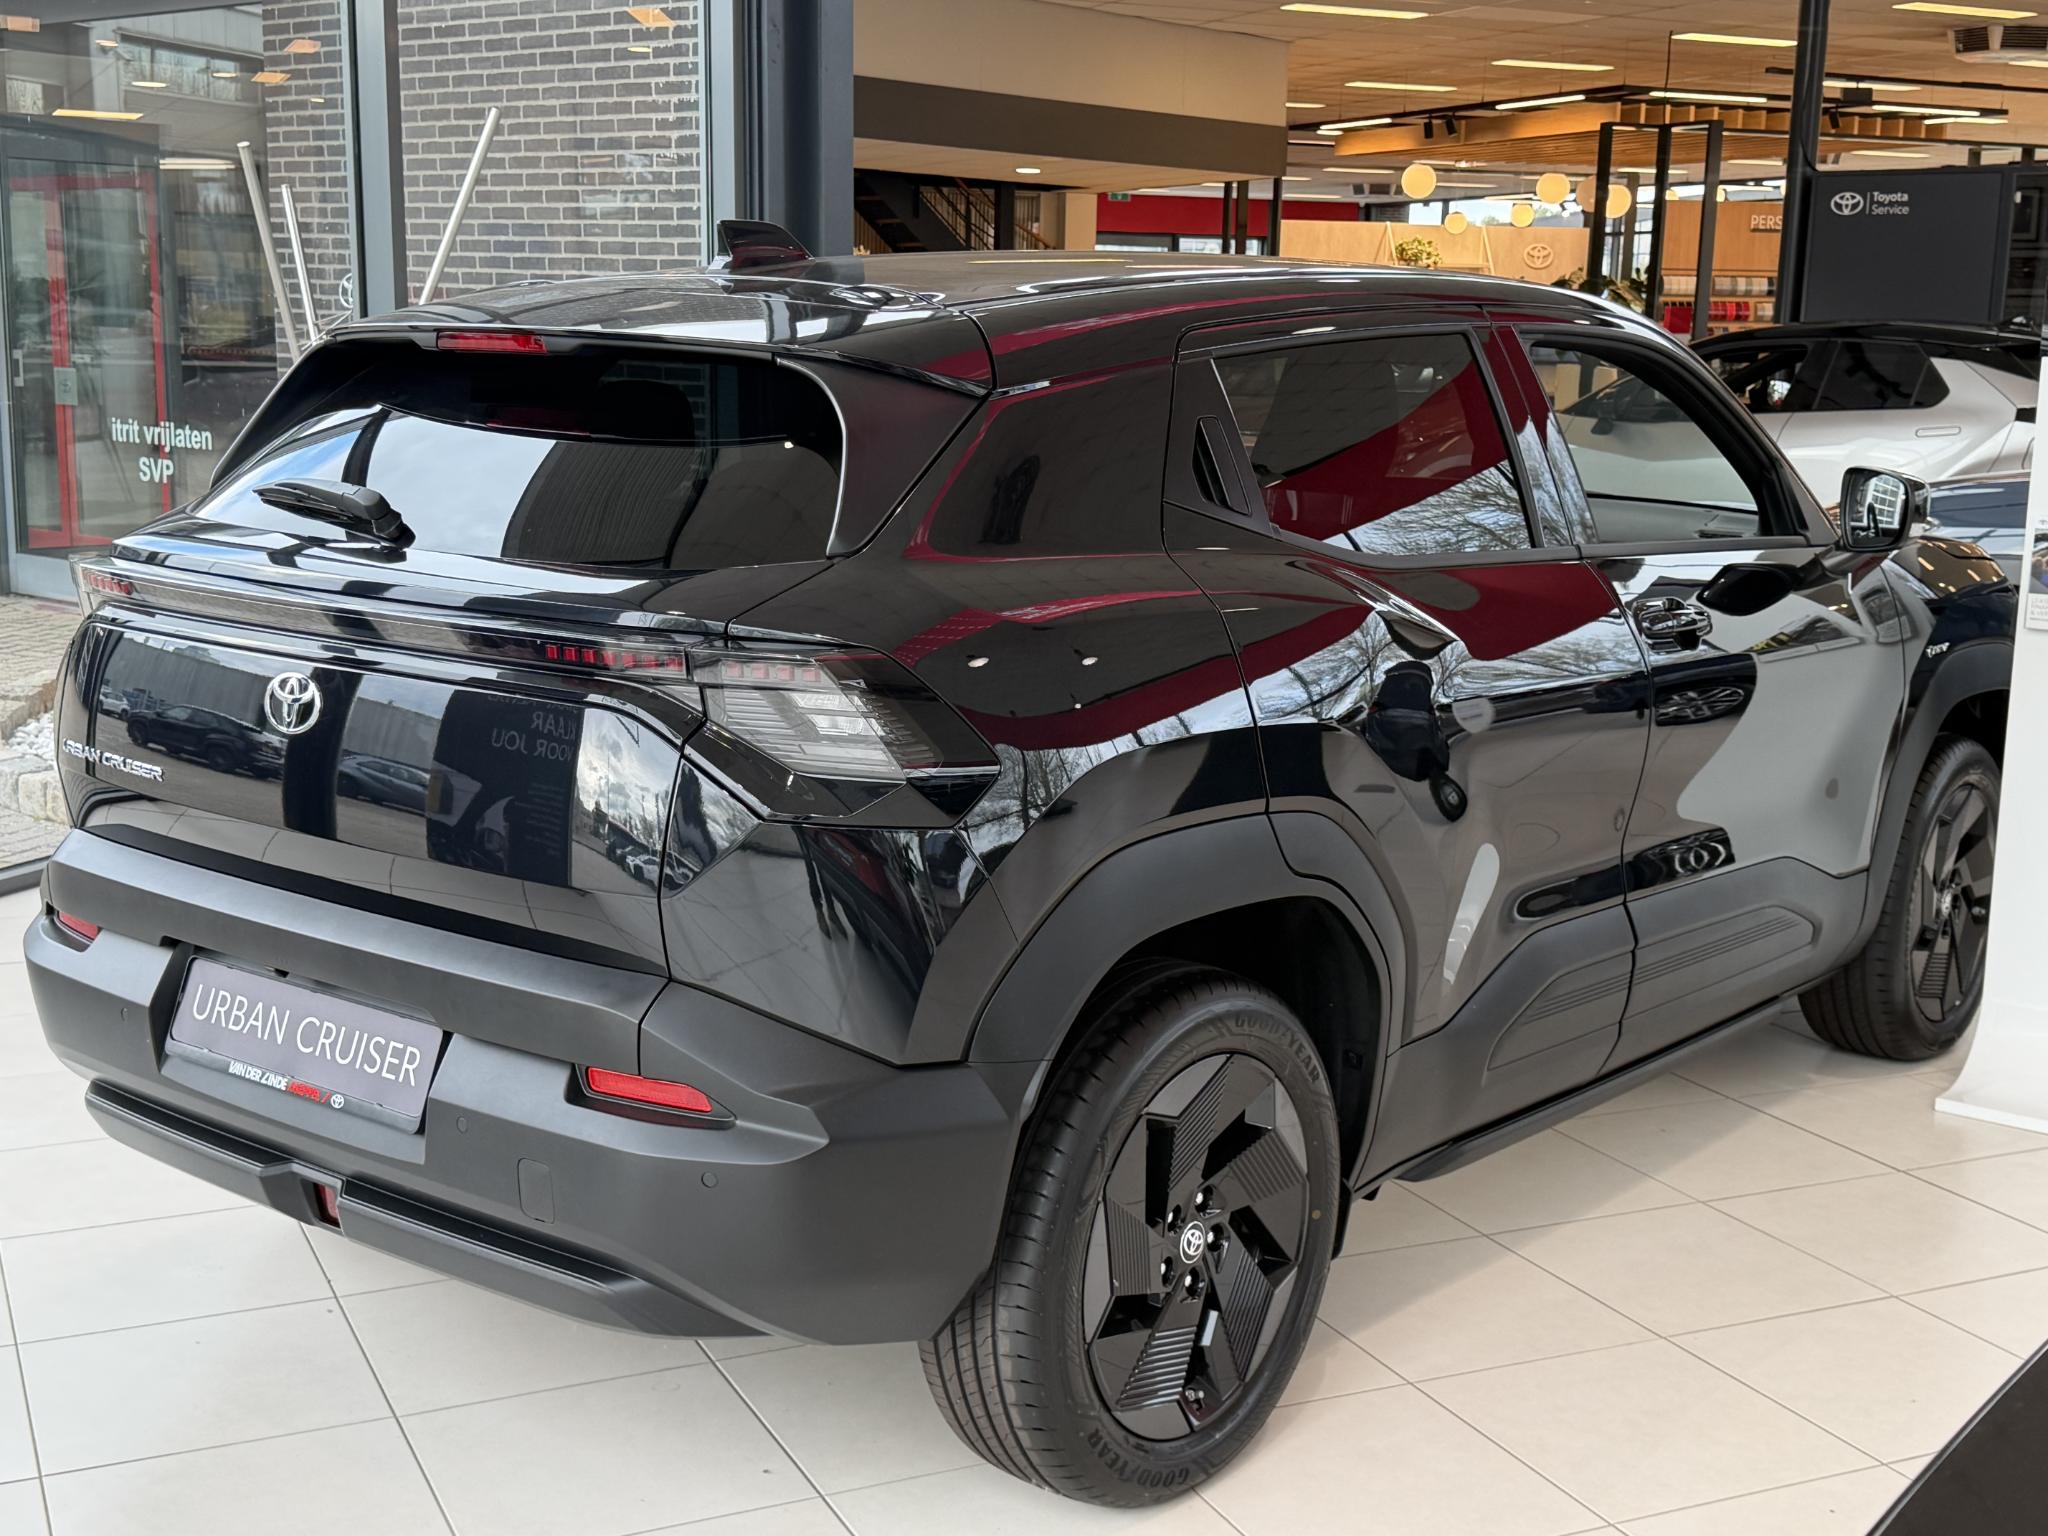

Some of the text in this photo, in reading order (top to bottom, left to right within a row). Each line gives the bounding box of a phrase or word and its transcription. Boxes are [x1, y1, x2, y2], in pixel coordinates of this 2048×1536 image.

[1871, 204, 1909, 215] Service
[1873, 191, 1909, 204] Toyota
[143, 421, 213, 453] vrijlaten
[139, 456, 174, 484] SVP
[101, 752, 163, 782] CRUISER
[192, 984, 421, 1087] URBAN CRUISER
[228, 1060, 247, 1078] VAN
[245, 1064, 263, 1083] DER
